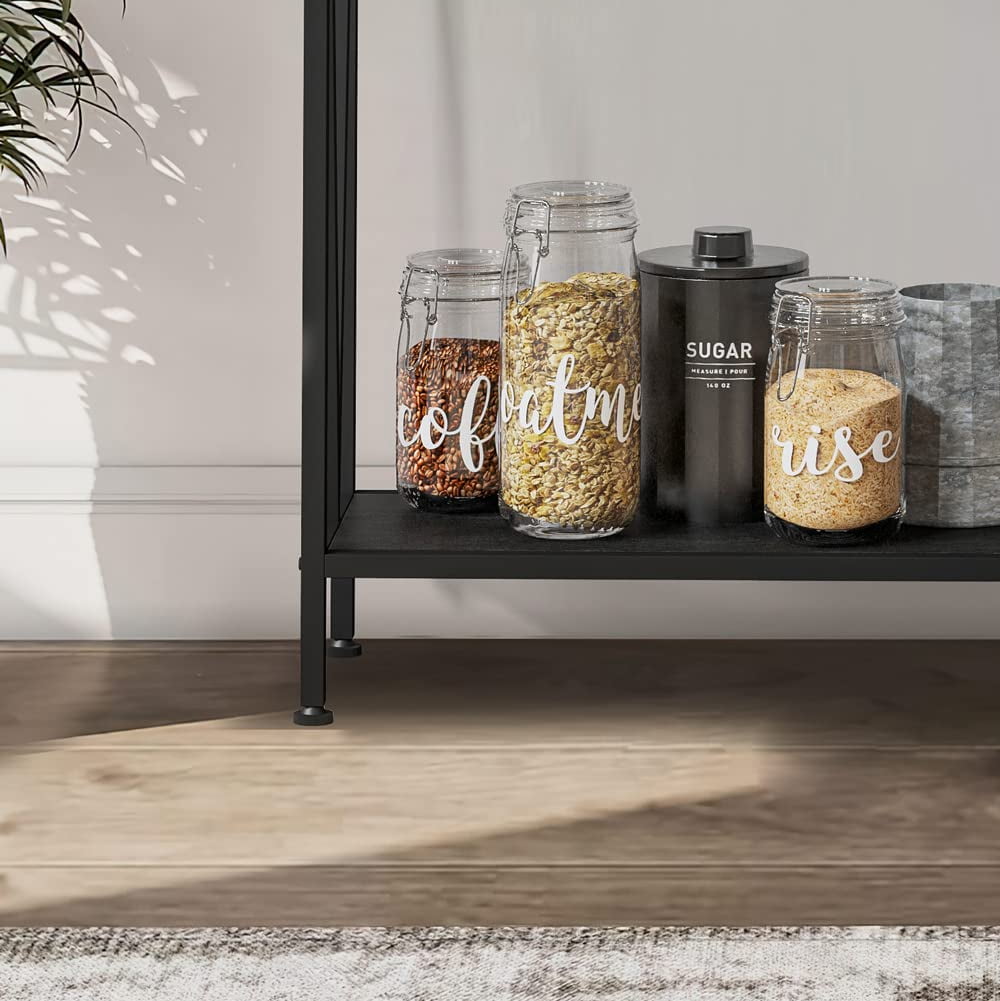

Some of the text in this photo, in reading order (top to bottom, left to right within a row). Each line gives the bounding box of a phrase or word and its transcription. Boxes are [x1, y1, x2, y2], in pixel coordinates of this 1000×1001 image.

[686, 342, 752, 359] SUGAR
[398, 376, 500, 472] cof
[772, 425, 900, 482] rise
